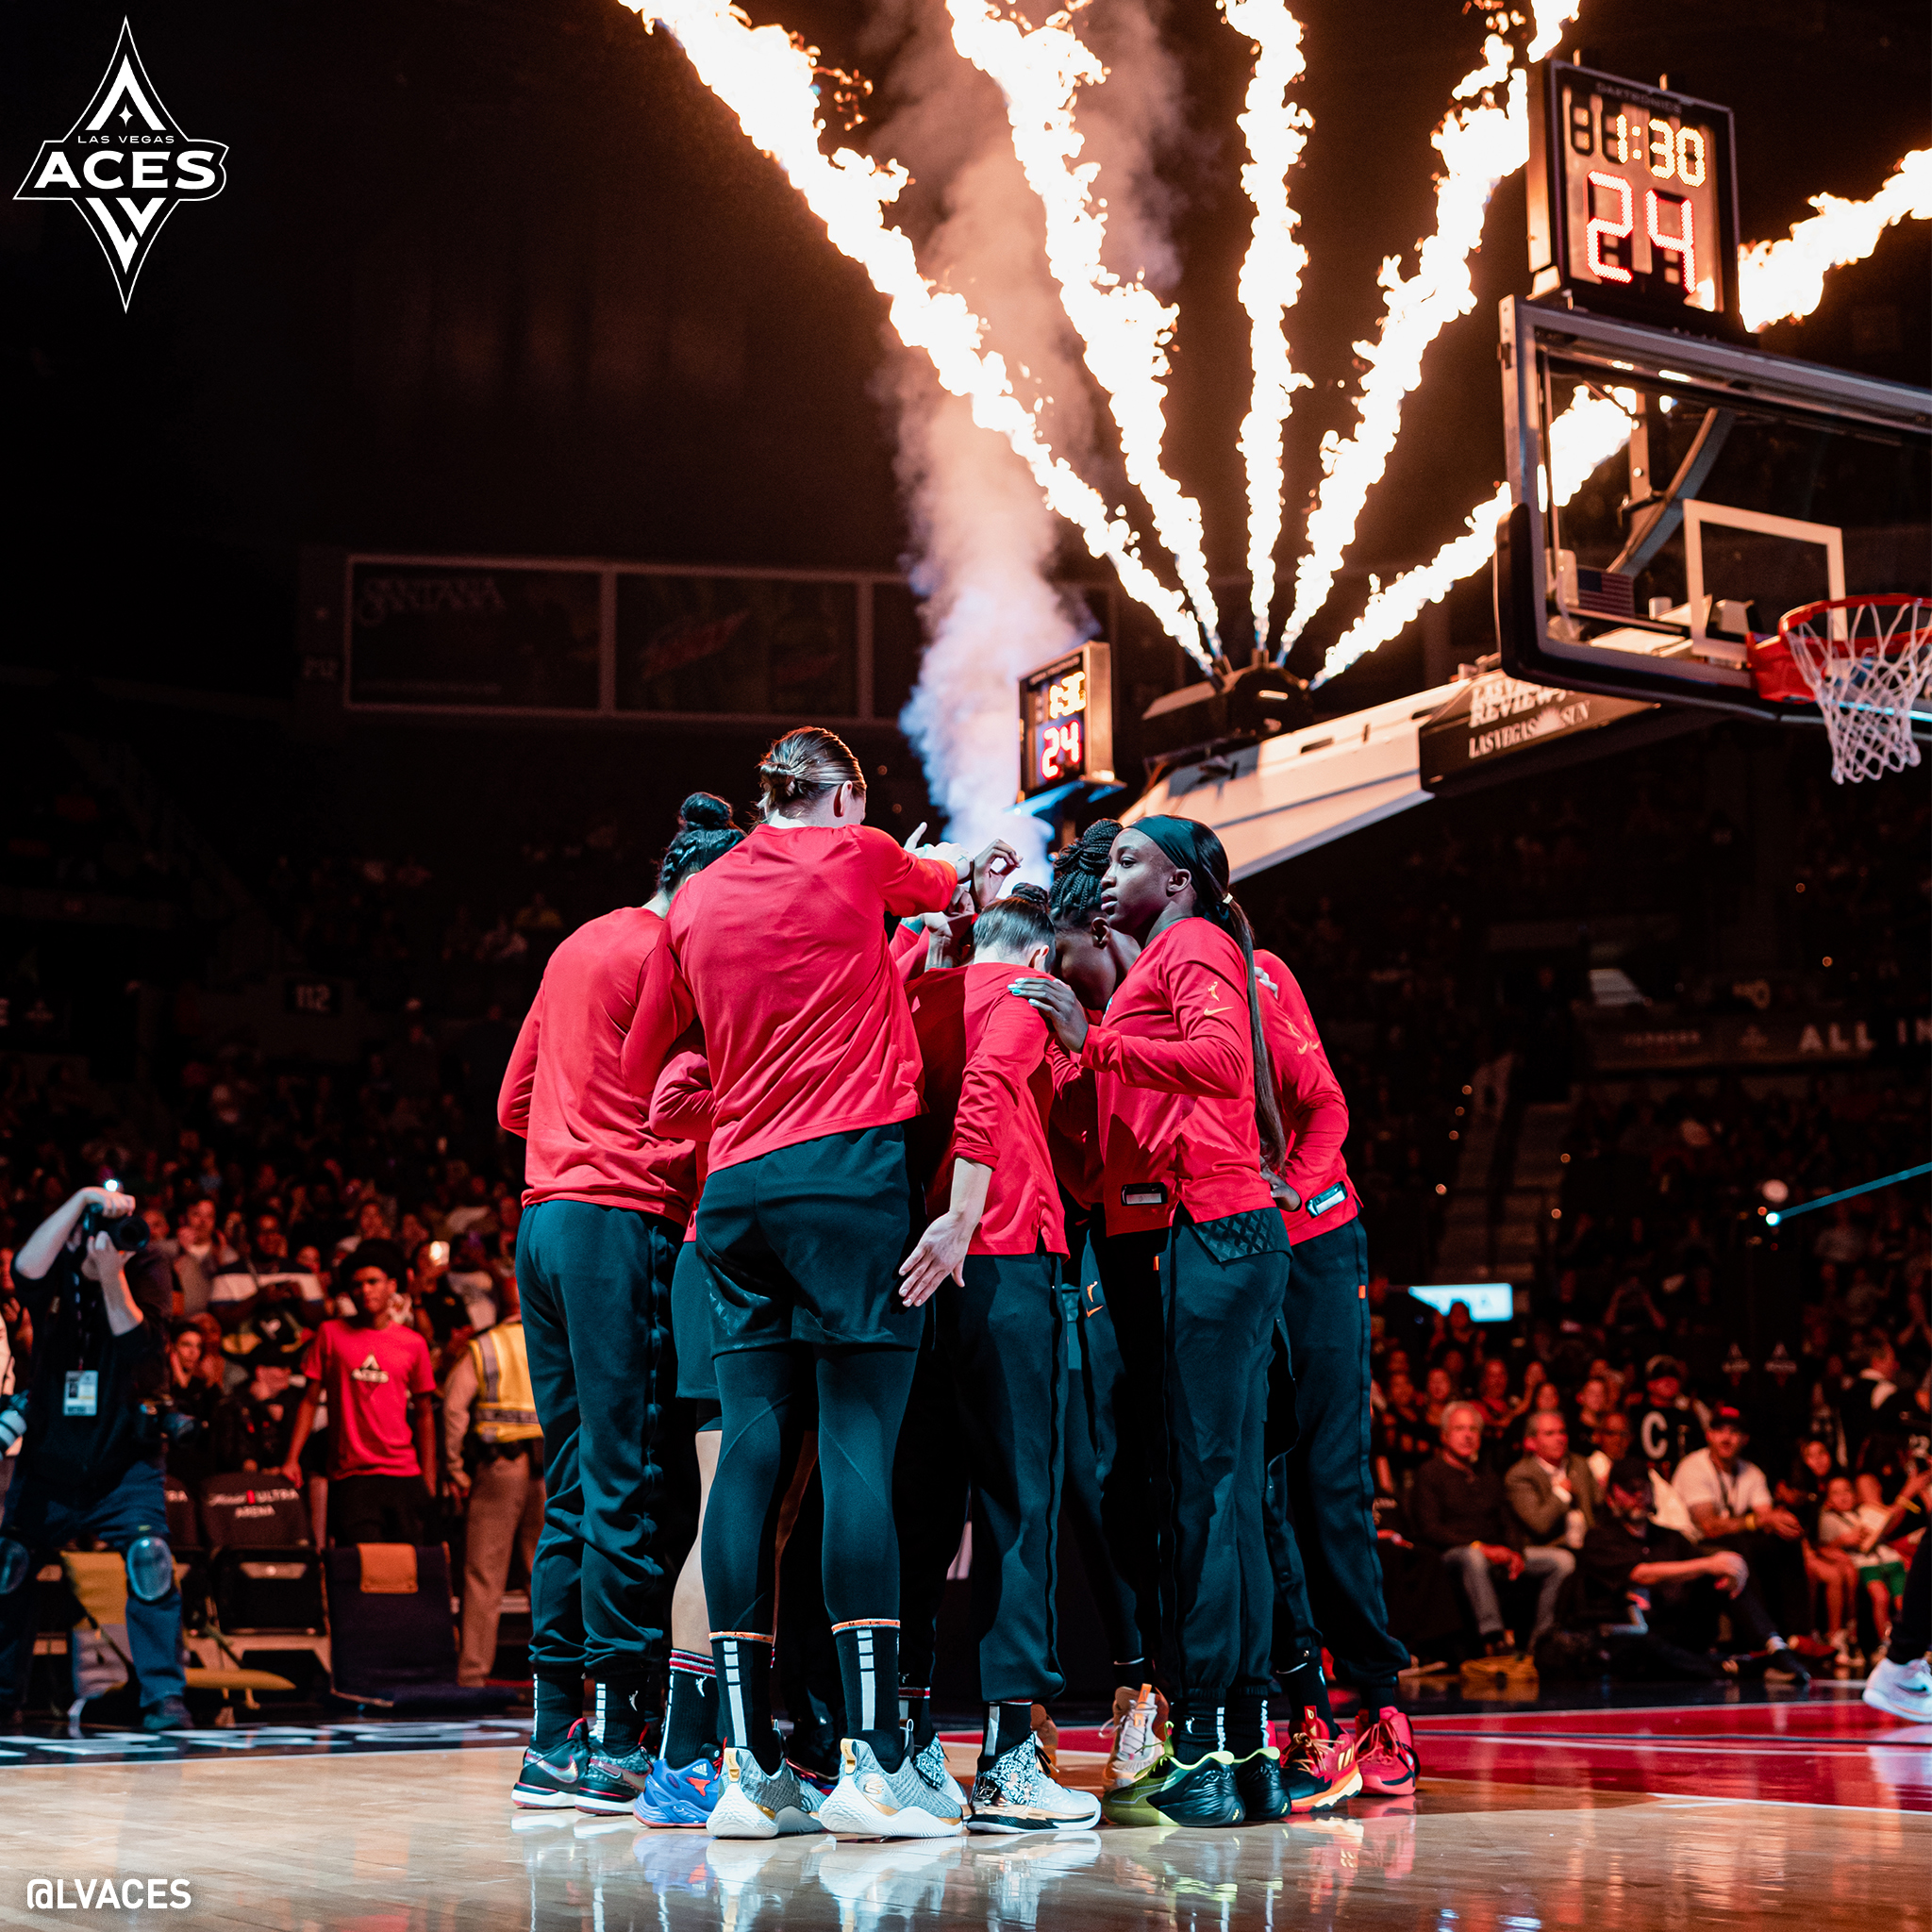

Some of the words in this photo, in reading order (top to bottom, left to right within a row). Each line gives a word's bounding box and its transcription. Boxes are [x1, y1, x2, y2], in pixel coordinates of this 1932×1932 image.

[1615, 113, 1707, 188] 1:30
[1586, 170, 1695, 294] 24
[1041, 720, 1081, 781] 24
[294, 983, 331, 1011] 112
[1798, 1020, 1878, 1054] ALL
